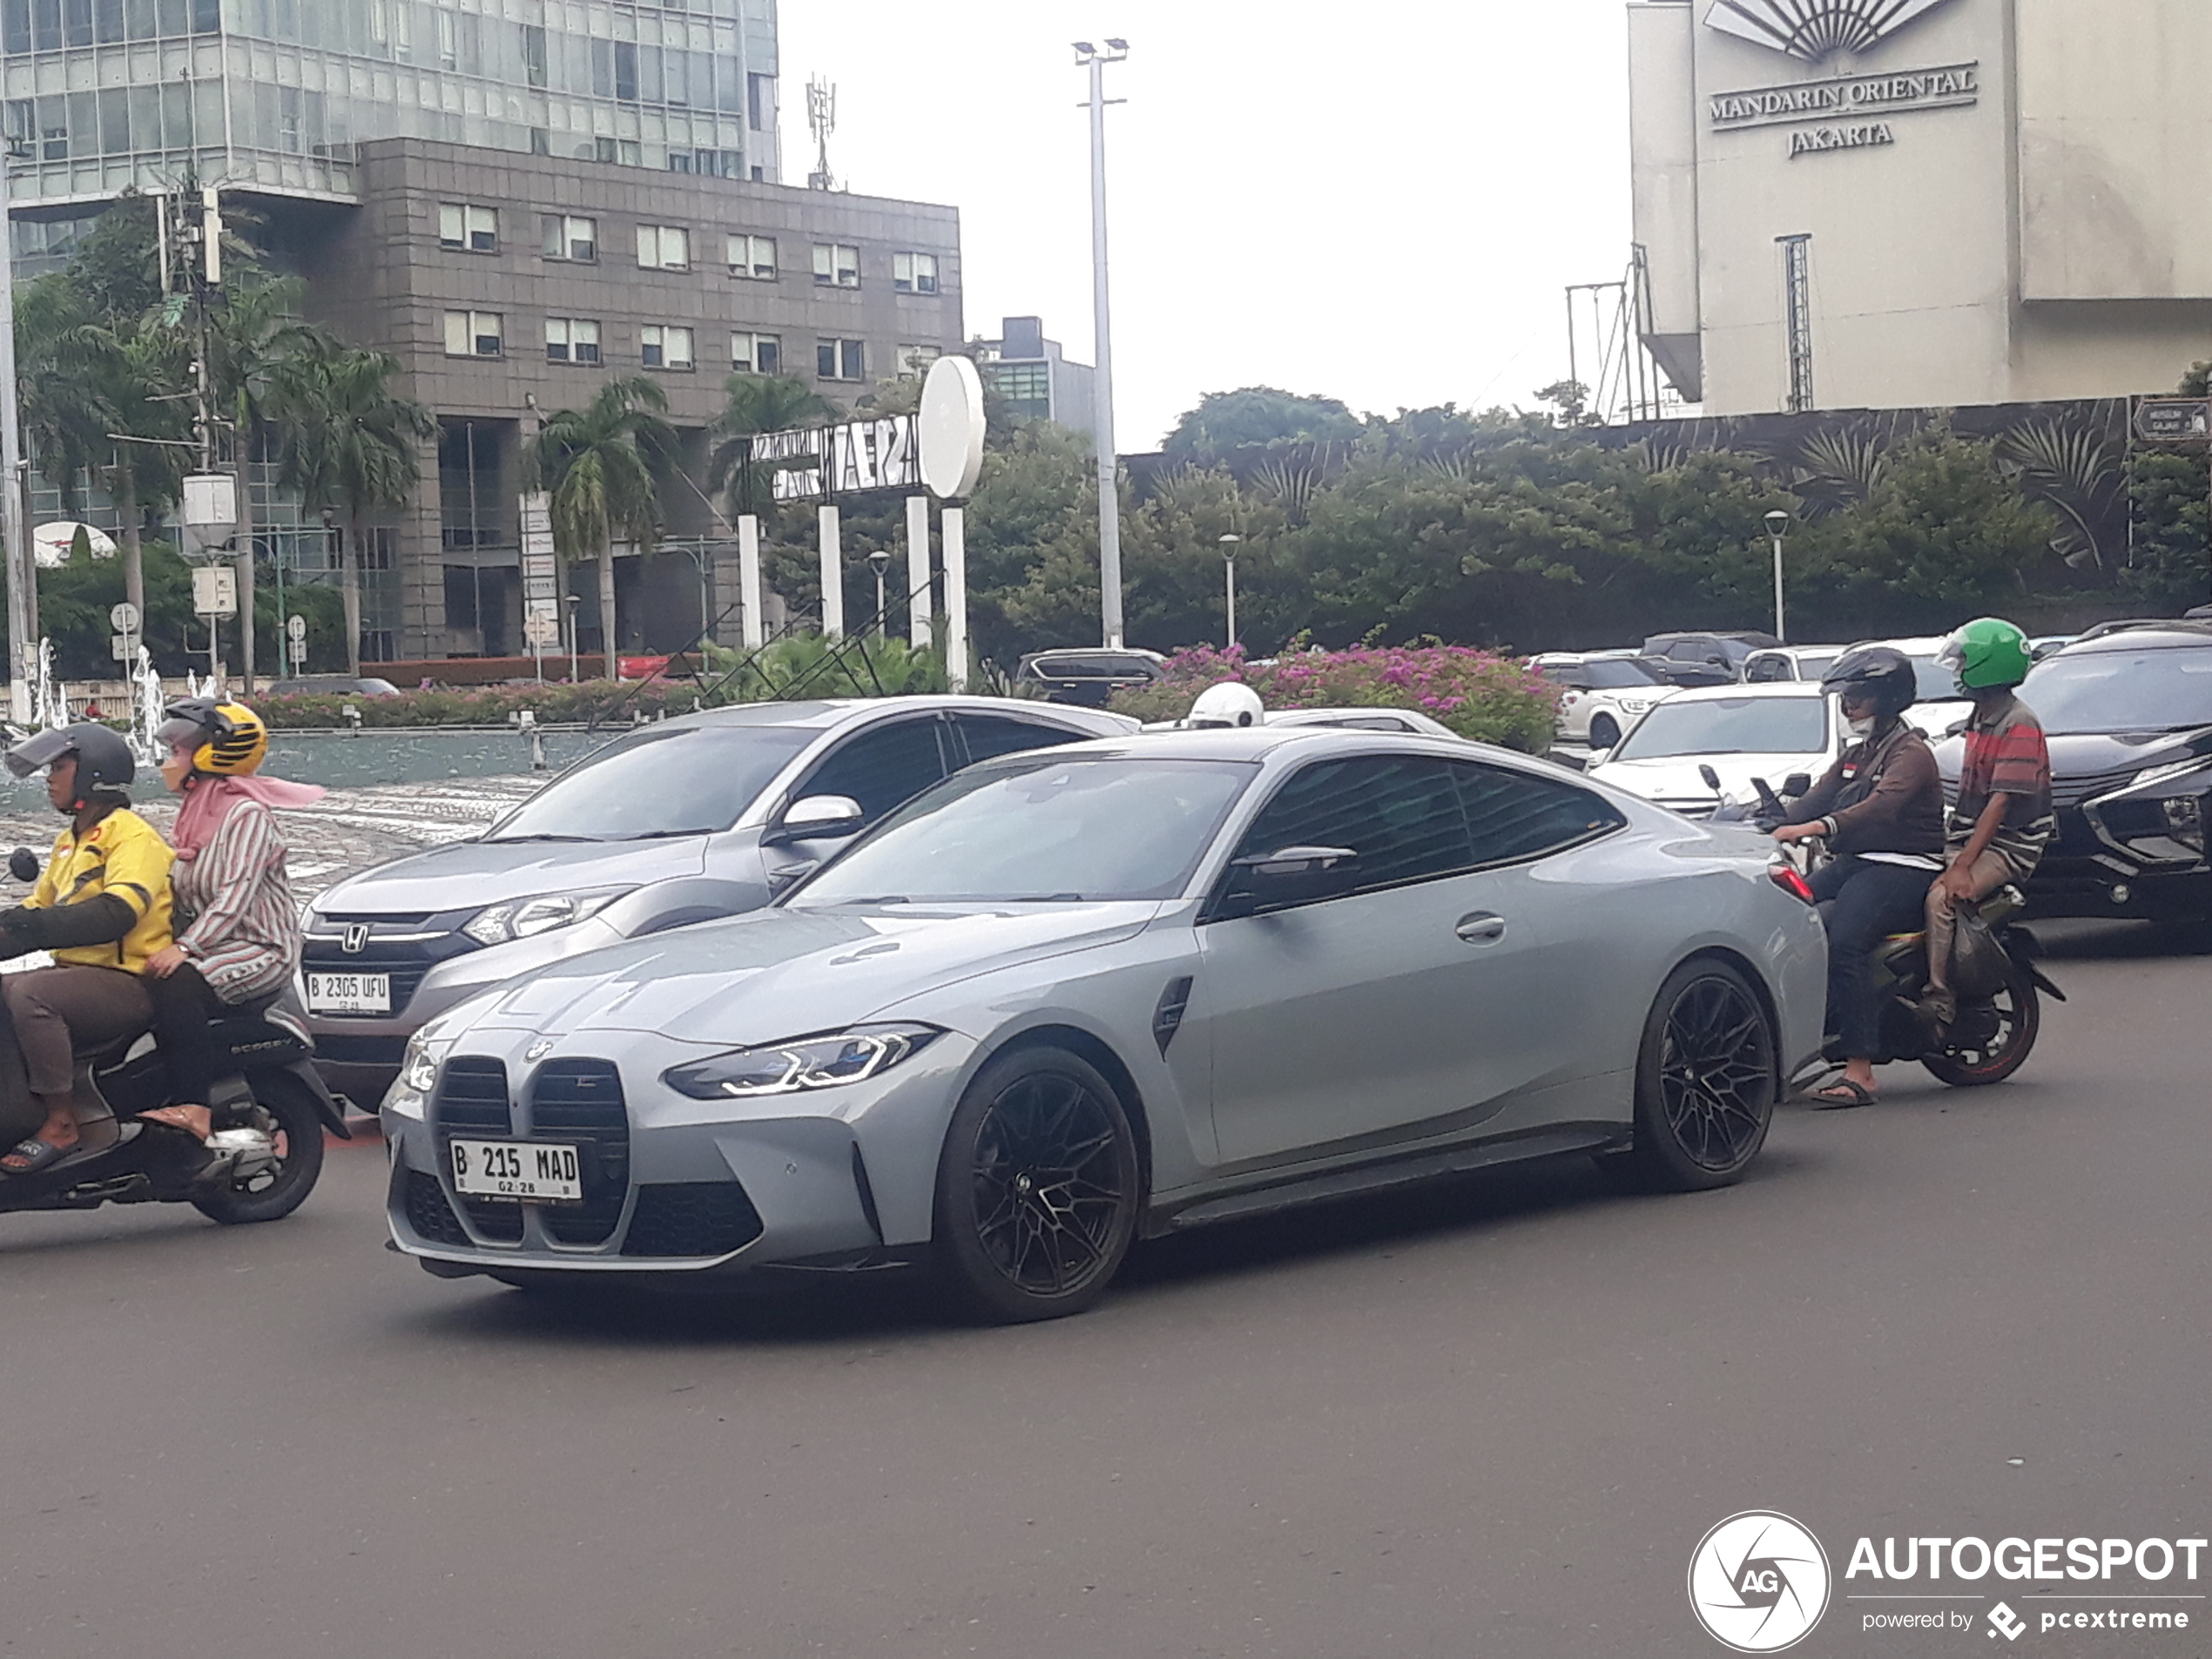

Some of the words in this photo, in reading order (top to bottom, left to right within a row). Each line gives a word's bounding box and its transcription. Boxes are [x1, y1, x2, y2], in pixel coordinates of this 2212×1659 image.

[1709, 85, 1843, 121] MANDARIN
[1847, 69, 1978, 103] ORIENTAL
[1787, 122, 1893, 159] JAKARTA
[311, 976, 320, 997] B
[327, 976, 358, 998] 2305
[454, 1144, 468, 1176] B
[482, 1146, 521, 1178] 215
[536, 1149, 577, 1181] MAD
